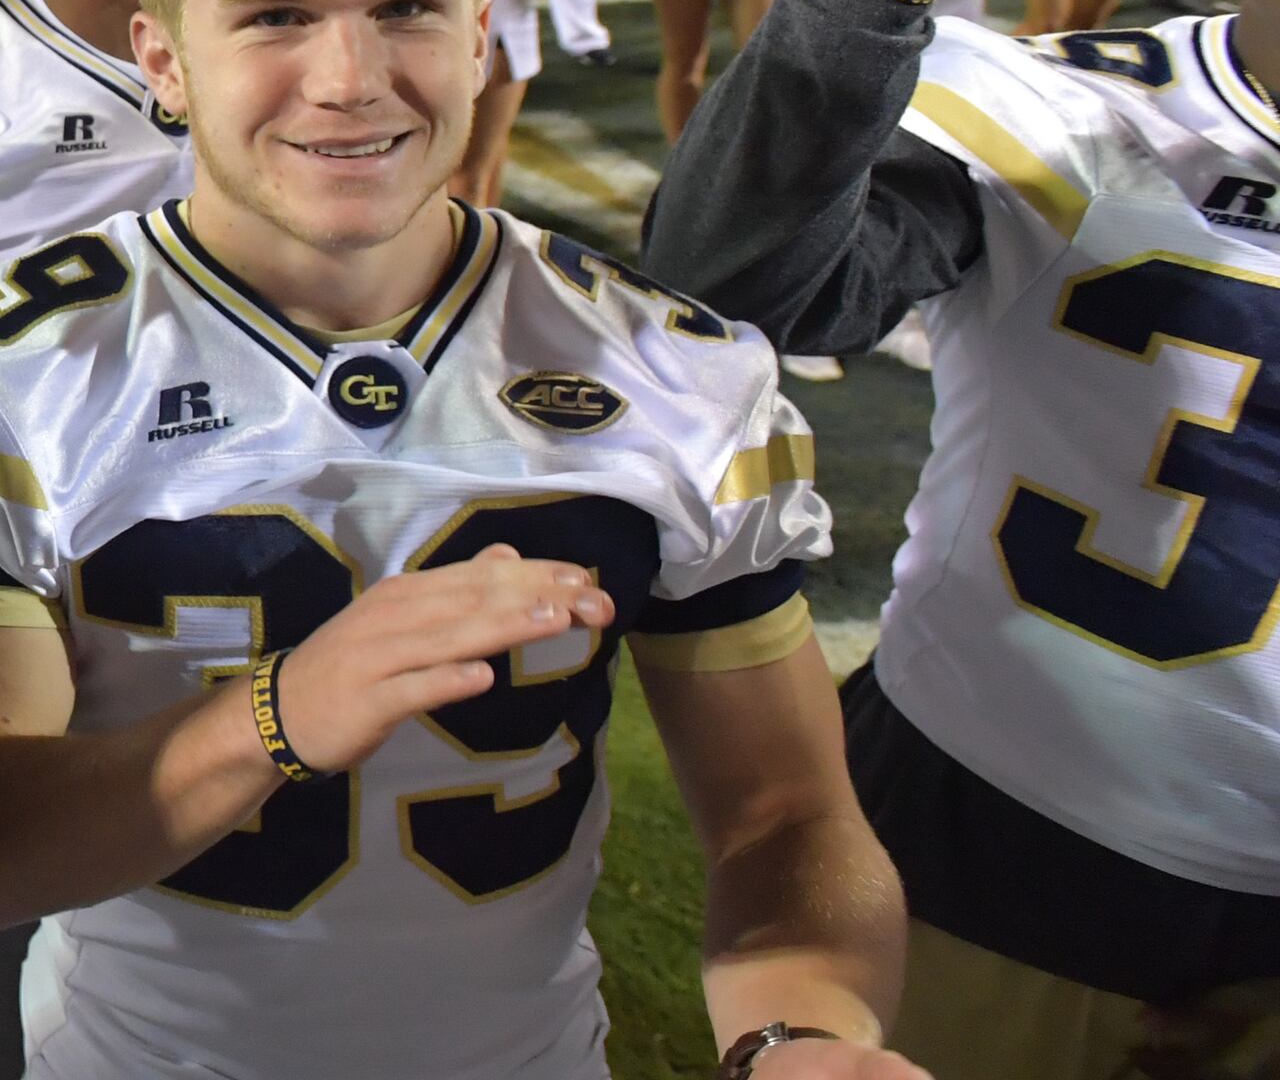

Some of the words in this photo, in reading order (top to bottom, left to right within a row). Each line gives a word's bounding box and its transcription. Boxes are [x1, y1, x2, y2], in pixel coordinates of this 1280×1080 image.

[54, 140, 109, 154] RUSSELL
[1197, 208, 1280, 235] USSEL
[339, 372, 400, 411] GT
[517, 384, 609, 407] ACC
[147, 414, 235, 444] RUSSELL
[69, 492, 664, 922] 39
